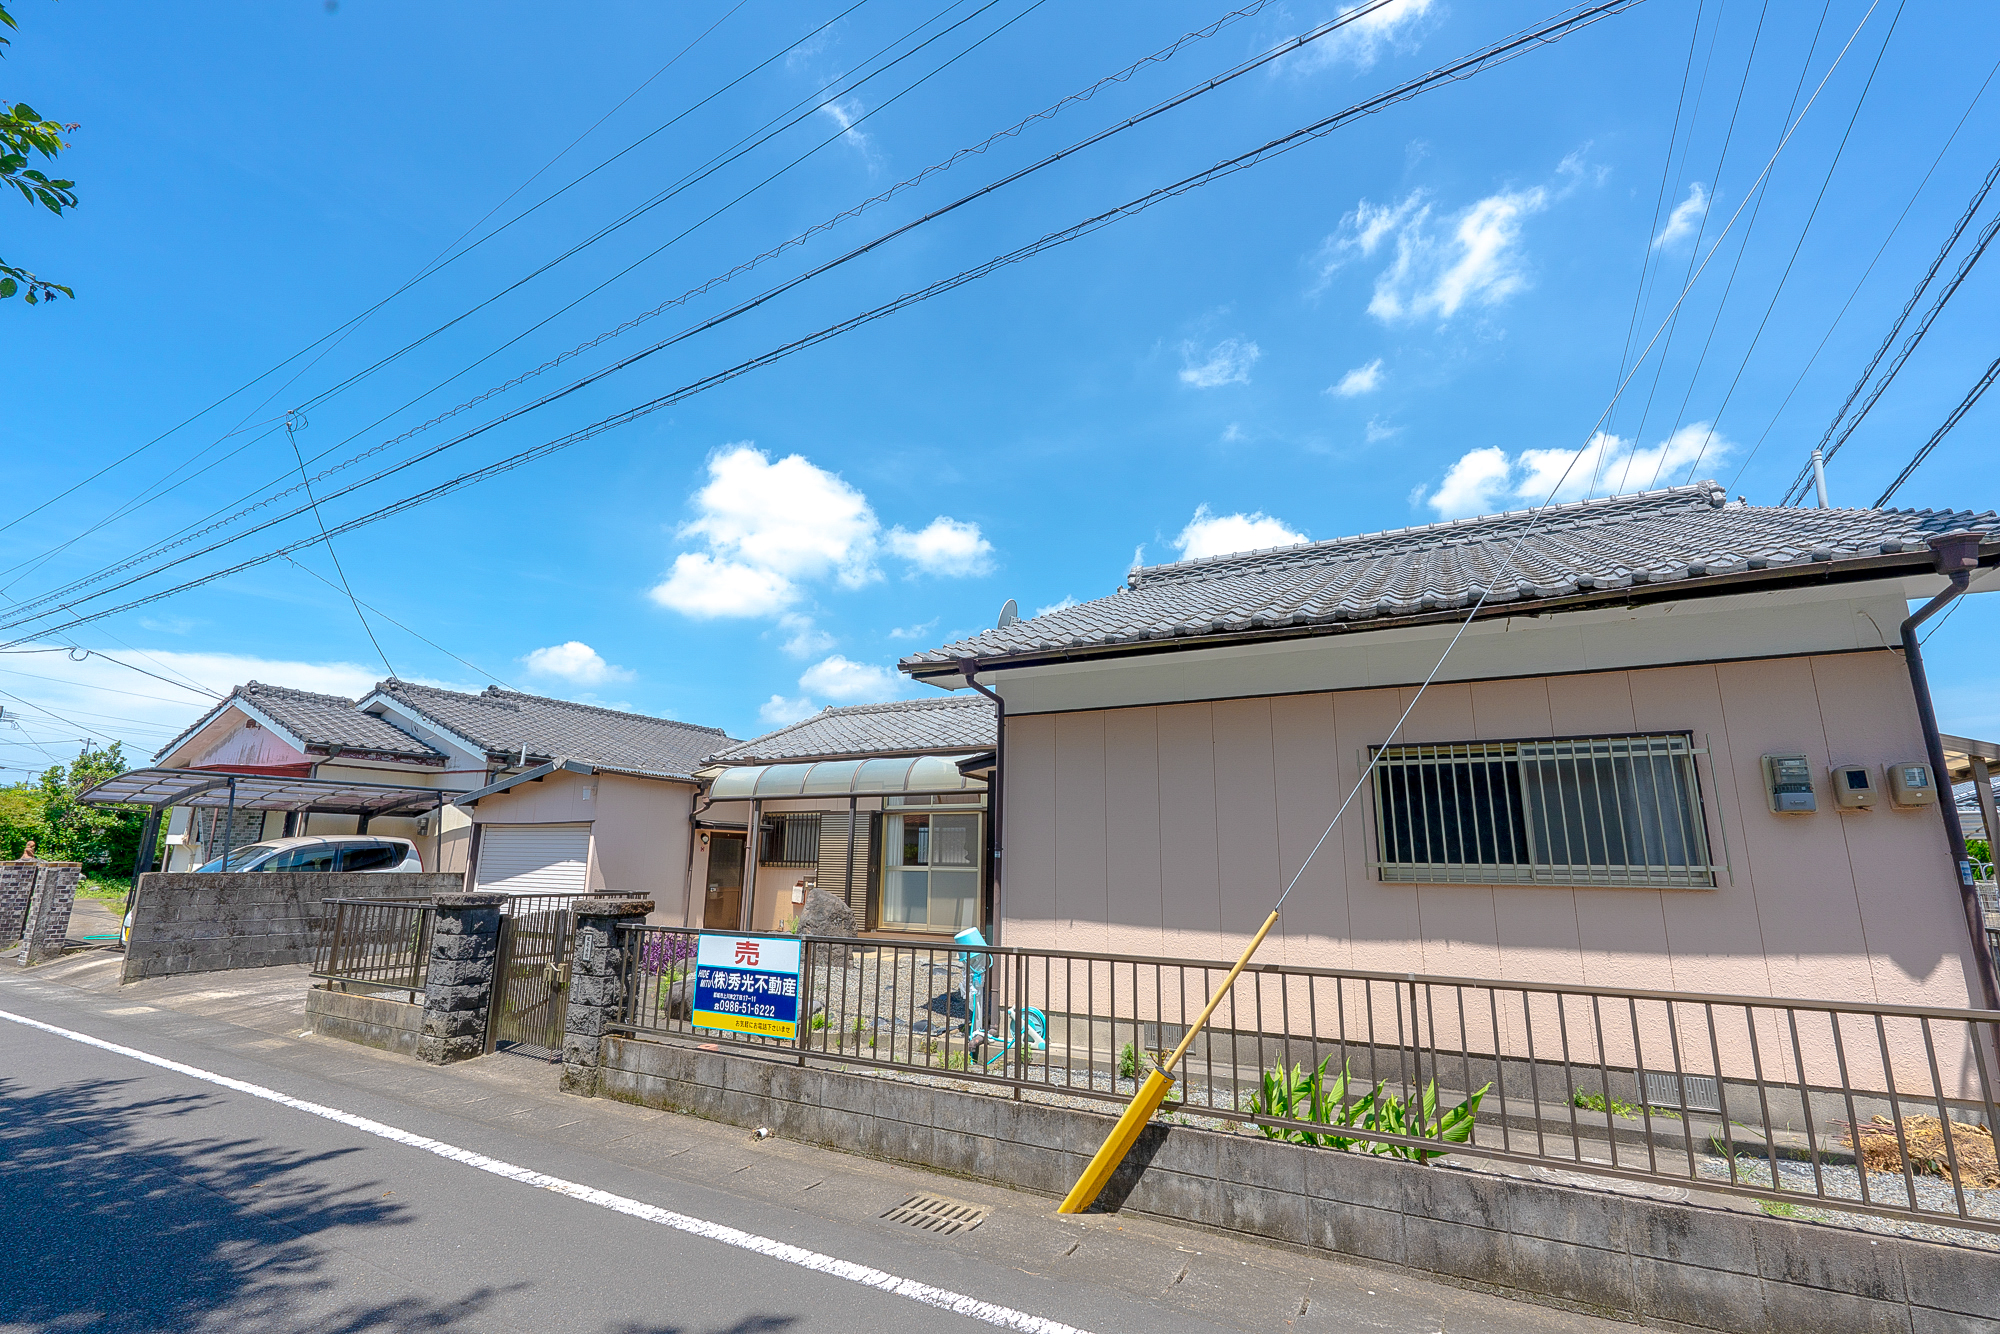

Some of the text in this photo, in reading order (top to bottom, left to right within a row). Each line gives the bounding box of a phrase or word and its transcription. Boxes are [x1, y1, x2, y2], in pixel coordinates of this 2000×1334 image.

[735, 941, 760, 966] 売
[712, 970, 797, 997] (株)秀光不動産
[719, 1000, 775, 1017] 0986-51-6222
